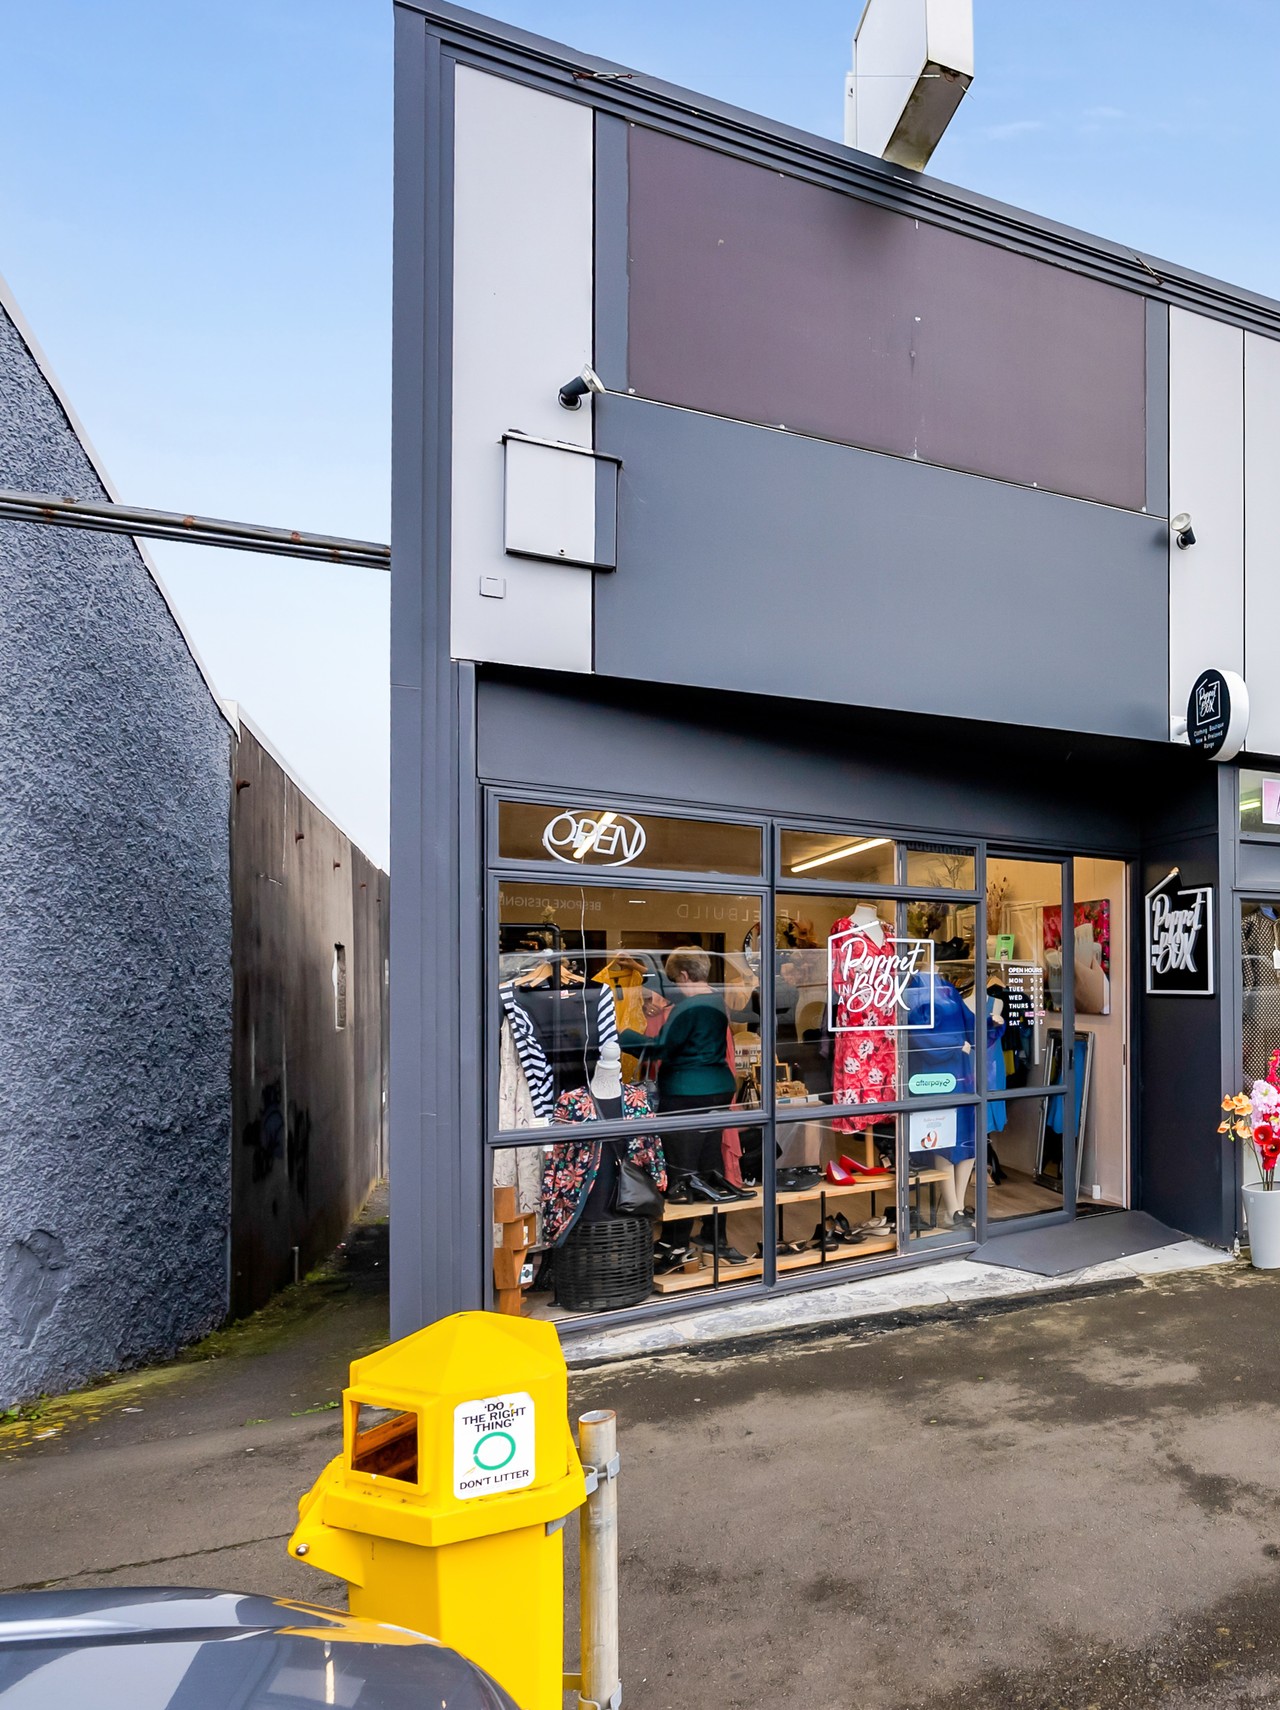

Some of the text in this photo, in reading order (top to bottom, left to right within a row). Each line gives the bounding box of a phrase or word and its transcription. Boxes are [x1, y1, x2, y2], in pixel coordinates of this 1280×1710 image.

[548, 814, 641, 858] OPEN
[841, 937, 925, 985] Poppet
[838, 984, 850, 995] IN
[838, 996, 845, 1005] A
[915, 1079, 942, 1088] afterpay
[462, 1407, 526, 1426] THE RIGHT
[459, 1469, 530, 1490] DON'T LITTER
